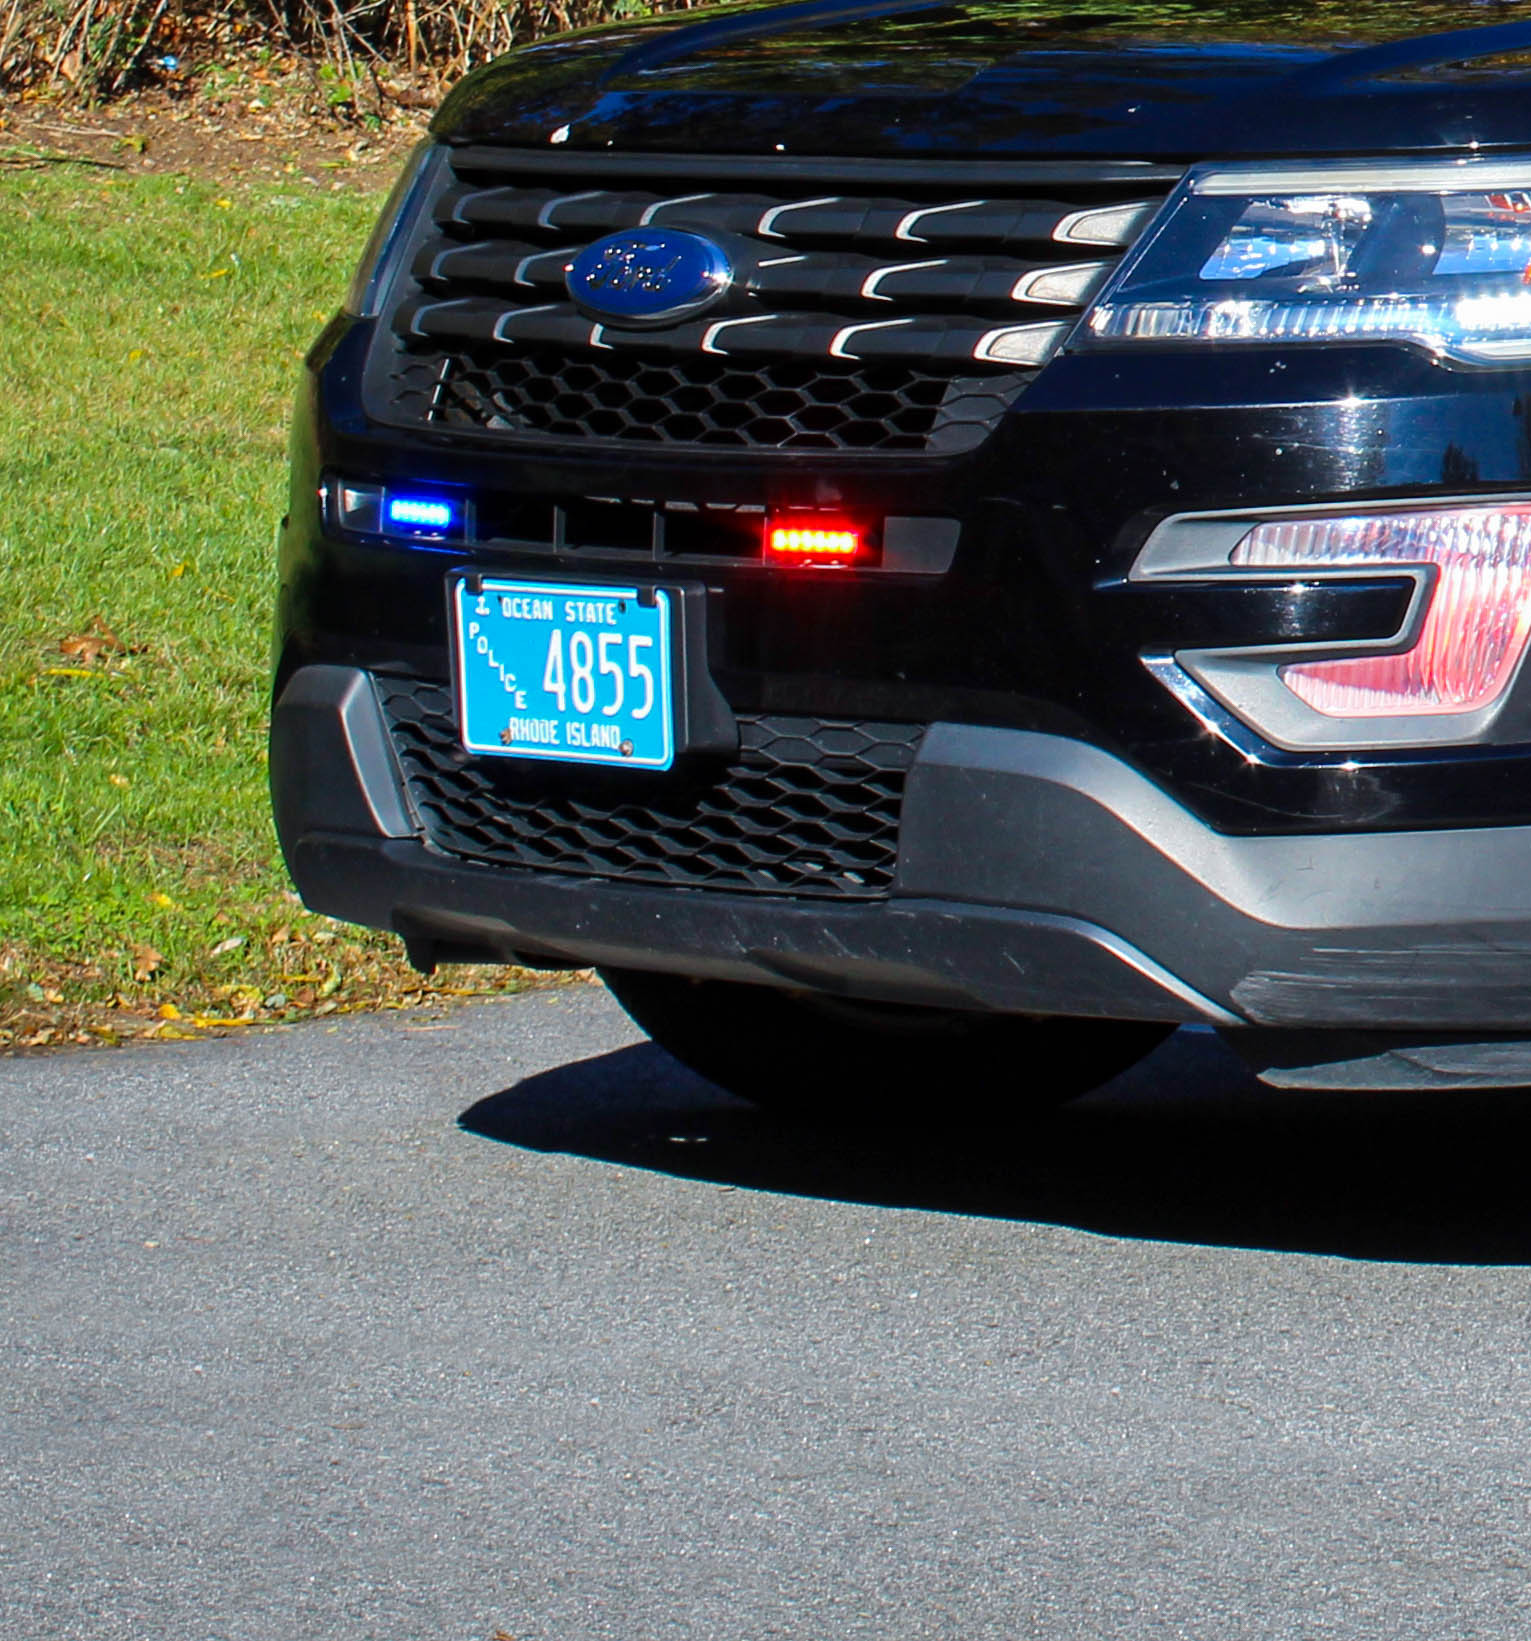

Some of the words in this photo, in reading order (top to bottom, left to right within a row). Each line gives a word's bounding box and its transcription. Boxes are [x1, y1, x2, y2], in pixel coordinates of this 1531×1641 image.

[501, 597, 553, 621] OCEAN
[565, 601, 617, 625] STATE
[468, 622, 528, 710] POLICE
[543, 628, 654, 720] 4855
[508, 716, 558, 744] RHODE
[566, 723, 620, 747] ISLAND
